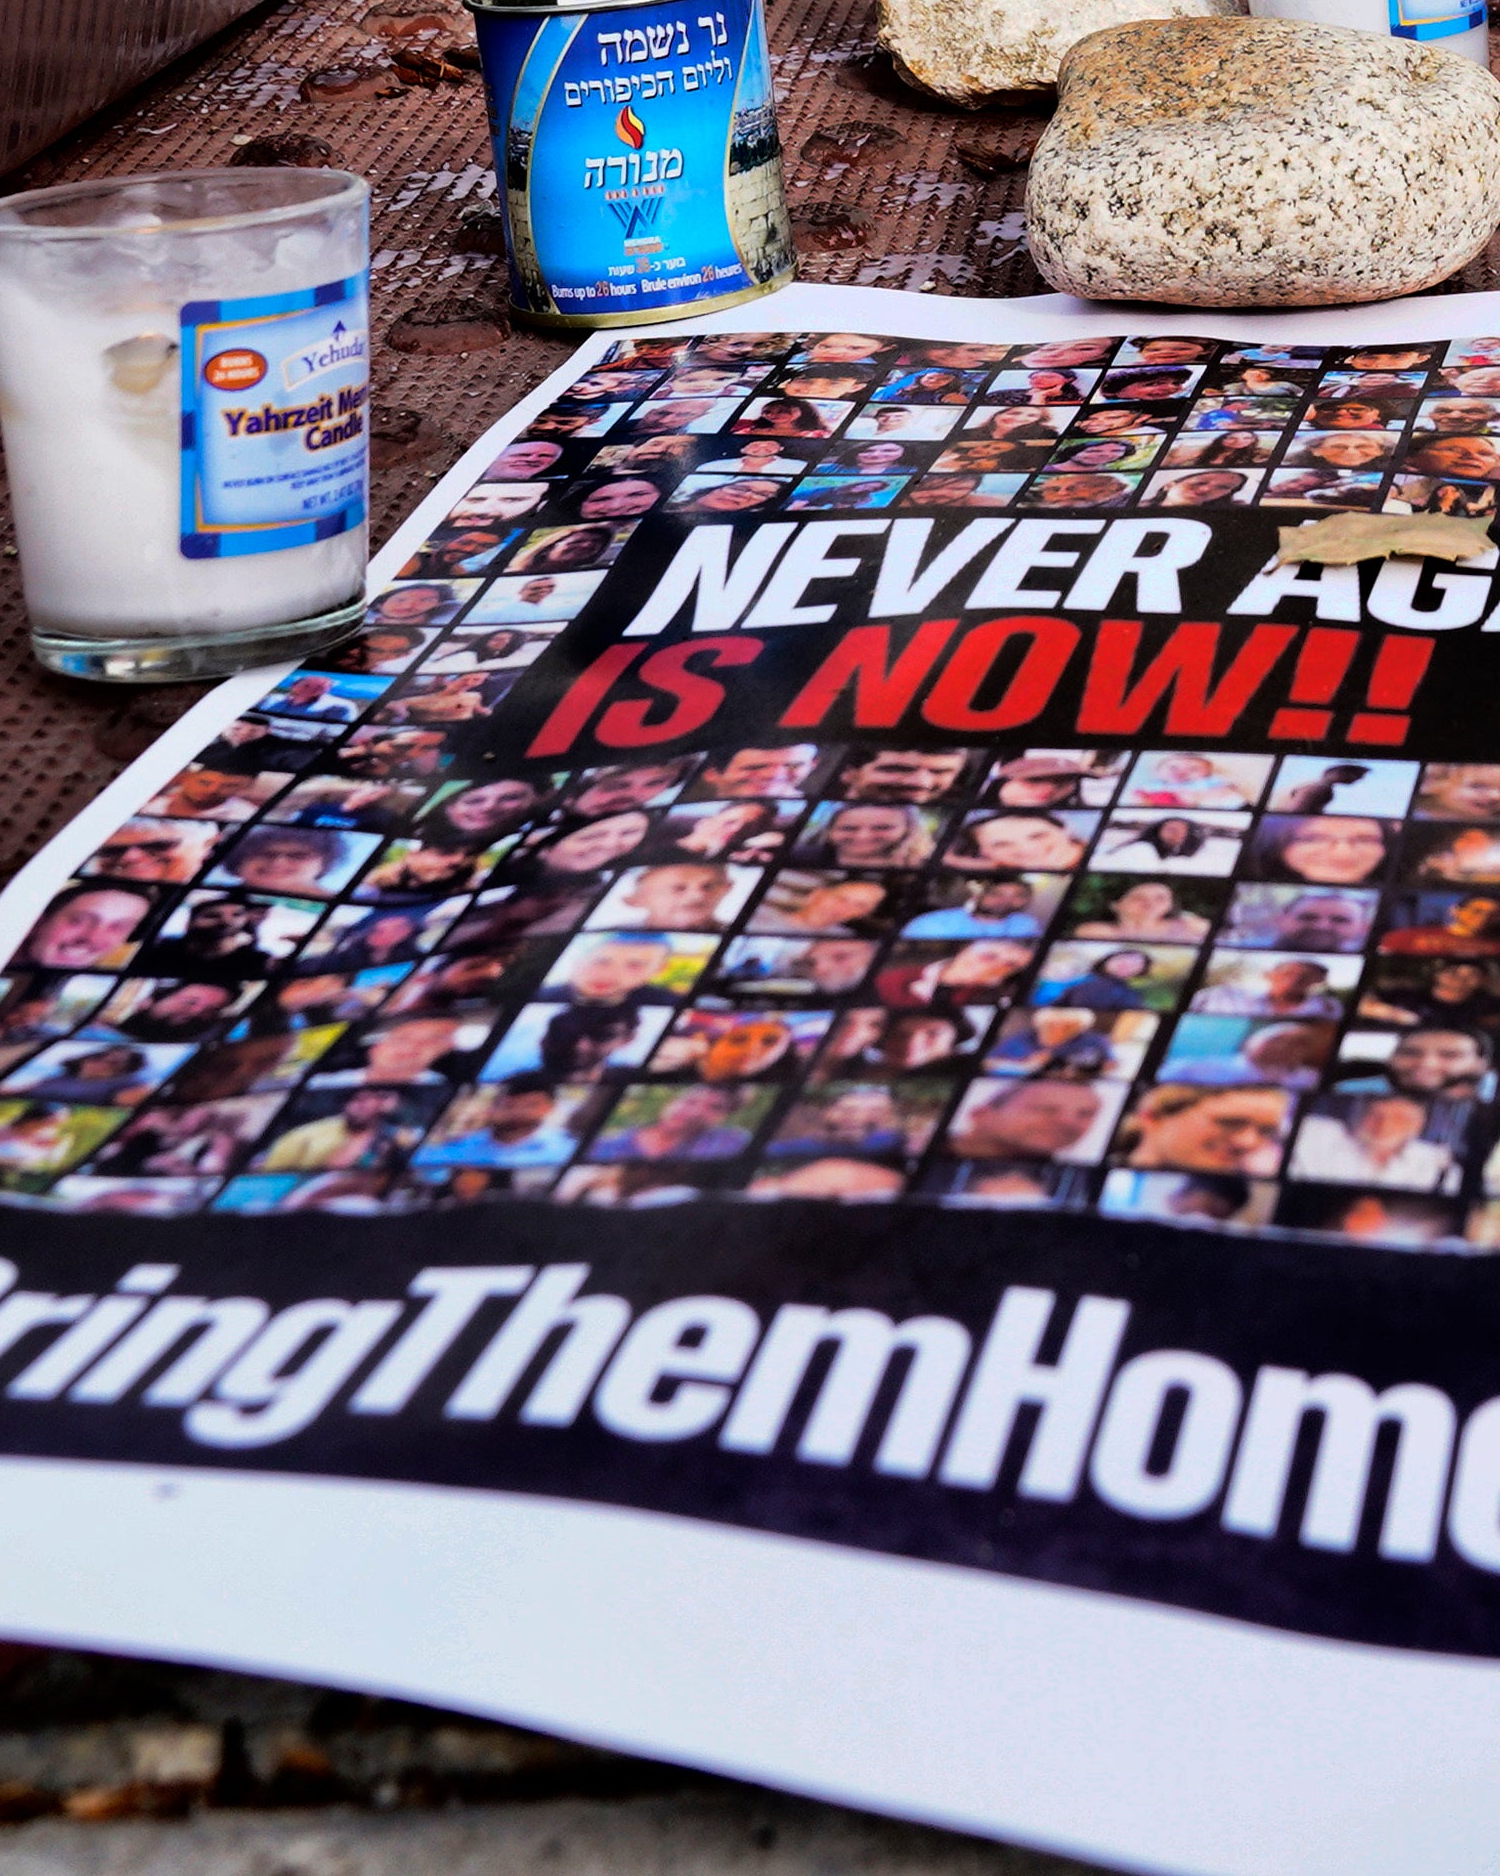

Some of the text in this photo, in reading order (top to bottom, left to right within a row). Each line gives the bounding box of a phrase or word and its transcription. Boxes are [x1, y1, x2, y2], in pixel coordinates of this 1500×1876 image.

[596, 11, 729, 66] נר נשמה
[563, 49, 733, 107] וליום הכיפורים
[583, 147, 684, 189] מנורה
[551, 284, 574, 299] Burns
[574, 286, 585, 301] up
[586, 286, 596, 298] to
[610, 282, 637, 297] hours
[224, 395, 333, 436] Yahrzeit
[305, 411, 364, 452] Candle
[622, 518, 1210, 637] NEVER
[525, 615, 1438, 759] IS NOW!!
